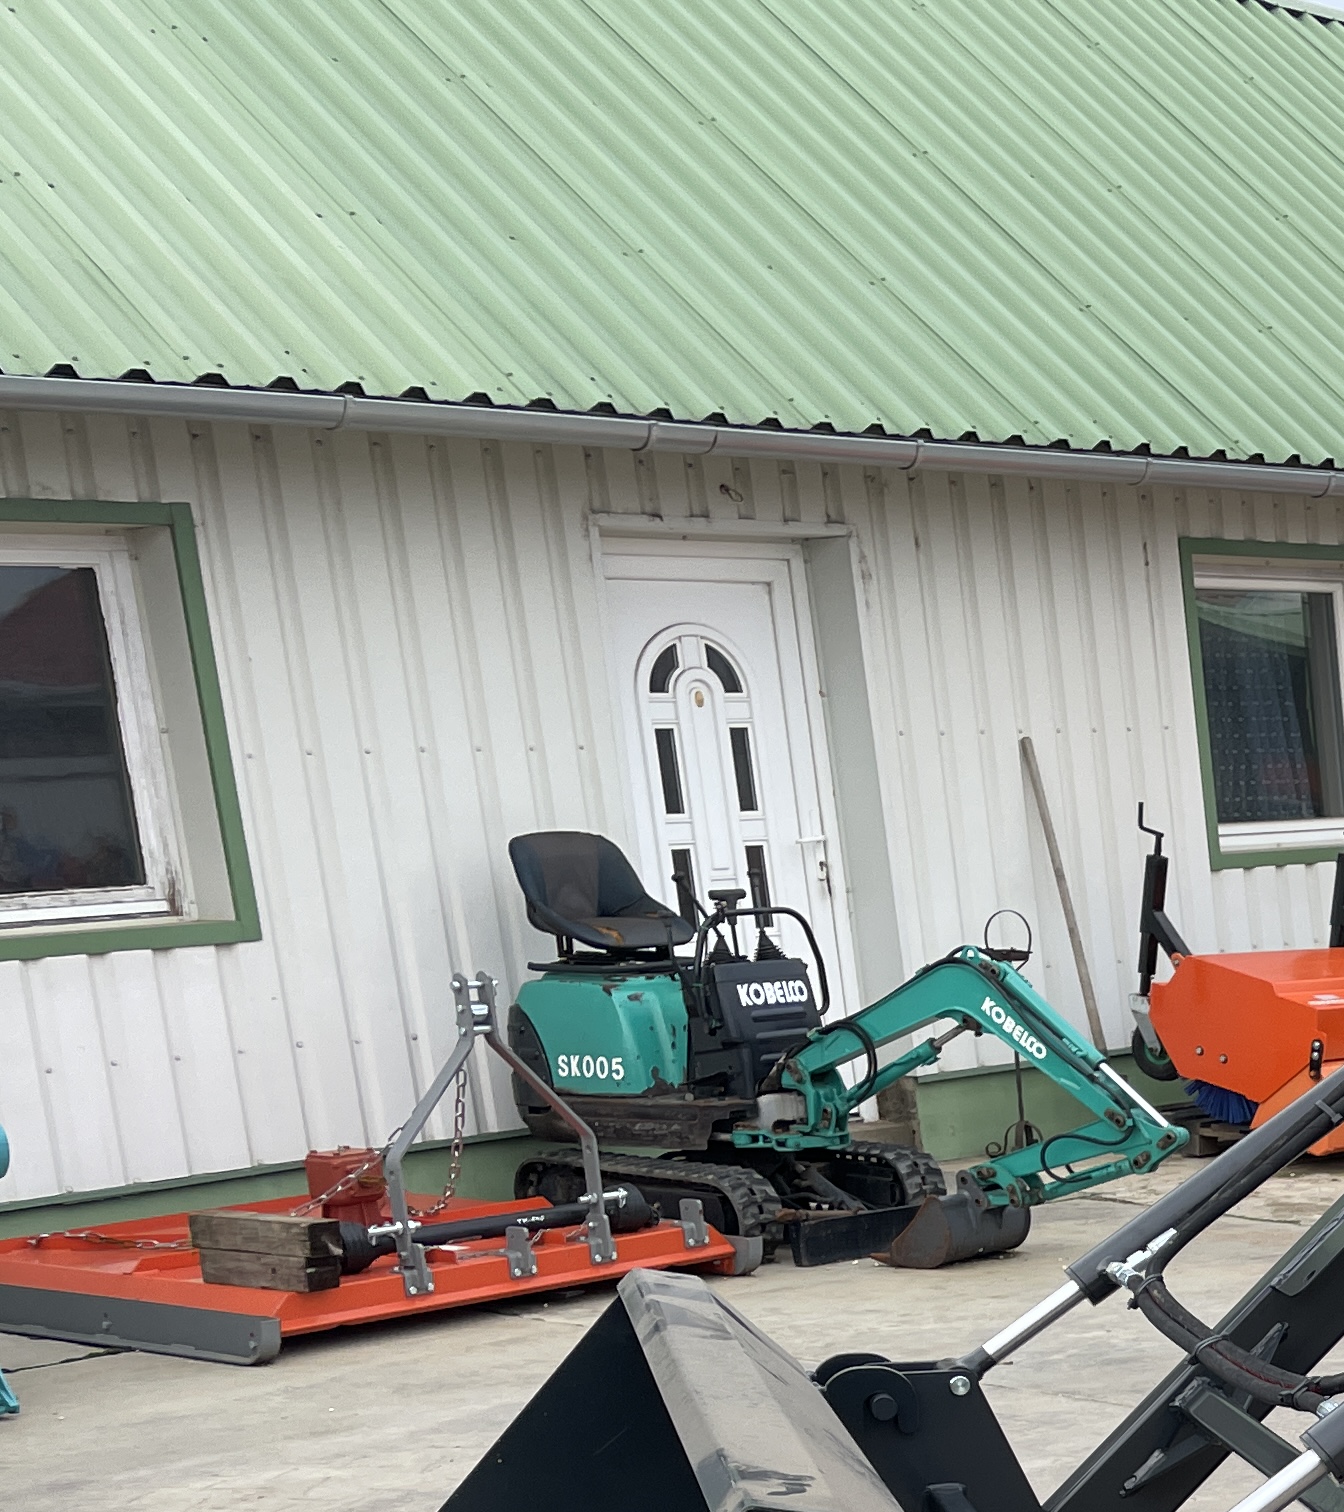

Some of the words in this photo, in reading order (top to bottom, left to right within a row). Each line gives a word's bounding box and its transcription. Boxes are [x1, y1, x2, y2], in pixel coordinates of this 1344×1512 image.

[736, 979, 808, 1007] KOBELCO
[981, 996, 1047, 1060] KOBELCO
[557, 1054, 625, 1080] SK005
